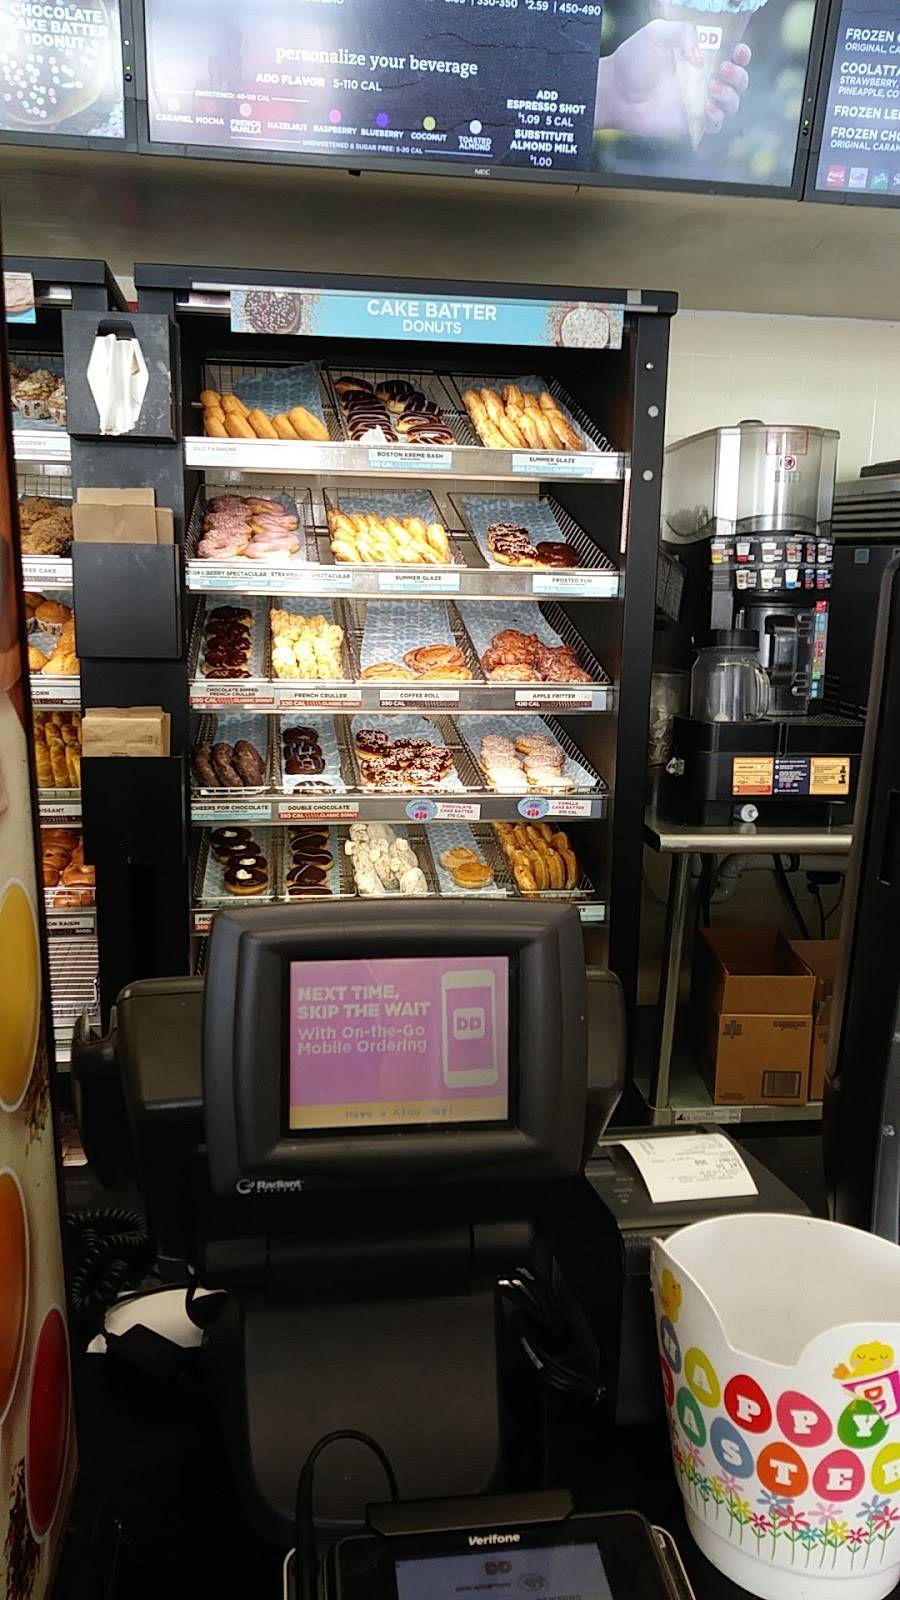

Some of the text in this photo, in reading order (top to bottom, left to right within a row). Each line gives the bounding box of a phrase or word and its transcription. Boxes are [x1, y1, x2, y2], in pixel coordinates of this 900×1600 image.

[11, 3, 103, 23] CHOCOLATE
[559, 3, 601, 15] 450-490
[51, 20, 108, 38] BATTER
[846, 28, 894, 42] FROZEN
[32, 34, 85, 49] DONUT
[699, 32, 718, 44] DD
[845, 42, 887, 54] ORIGINAL,
[276, 48, 478, 78] personalize your beverage
[256, 73, 382, 92] ADD FLAVOR 5-110 CAL
[840, 76, 899, 88] STRAWBERRY,
[536, 90, 558, 100] ADD
[838, 86, 884, 98] PINEAPPLE,
[507, 100, 586, 114] ESPRESSO SHOT
[834, 105, 881, 118] FROZEN
[156, 113, 193, 123] CARAMEL
[196, 116, 224, 125] MOCHA
[230, 118, 261, 127] FRENCH
[518, 112, 574, 127] $1.09 5 CAL
[268, 122, 307, 131] HAZELNUT
[313, 125, 356, 135] RASPBERRY
[360, 128, 404, 138] BLUEBERRY
[411, 132, 447, 142] COCONUT
[515, 129, 574, 142] SUBSTITUTE
[831, 127, 878, 140] FROZEN
[356, 143, 376, 151] SUGAR
[458, 136, 492, 145] TOASTED
[459, 143, 491, 151] ALMOND
[510, 140, 577, 154] ALMOND MILK
[830, 140, 871, 150] ORIGINAL,
[530, 155, 552, 167] $1.00
[474, 168, 490, 176] NEC
[367, 299, 496, 321] CAKE BATTER
[402, 320, 462, 334] DONUTS
[298, 984, 400, 1002] NEXT TIME,
[298, 1002, 431, 1020] SKIP THE WAIT
[457, 1017, 482, 1030] DD
[298, 1025, 425, 1040] With On-the-Go
[298, 1038, 427, 1055] Mobile Ordering
[257, 1180, 302, 1189] Radiant
[664, 1327, 880, 1438] HAPPY
[468, 1533, 521, 1546] Verifone
